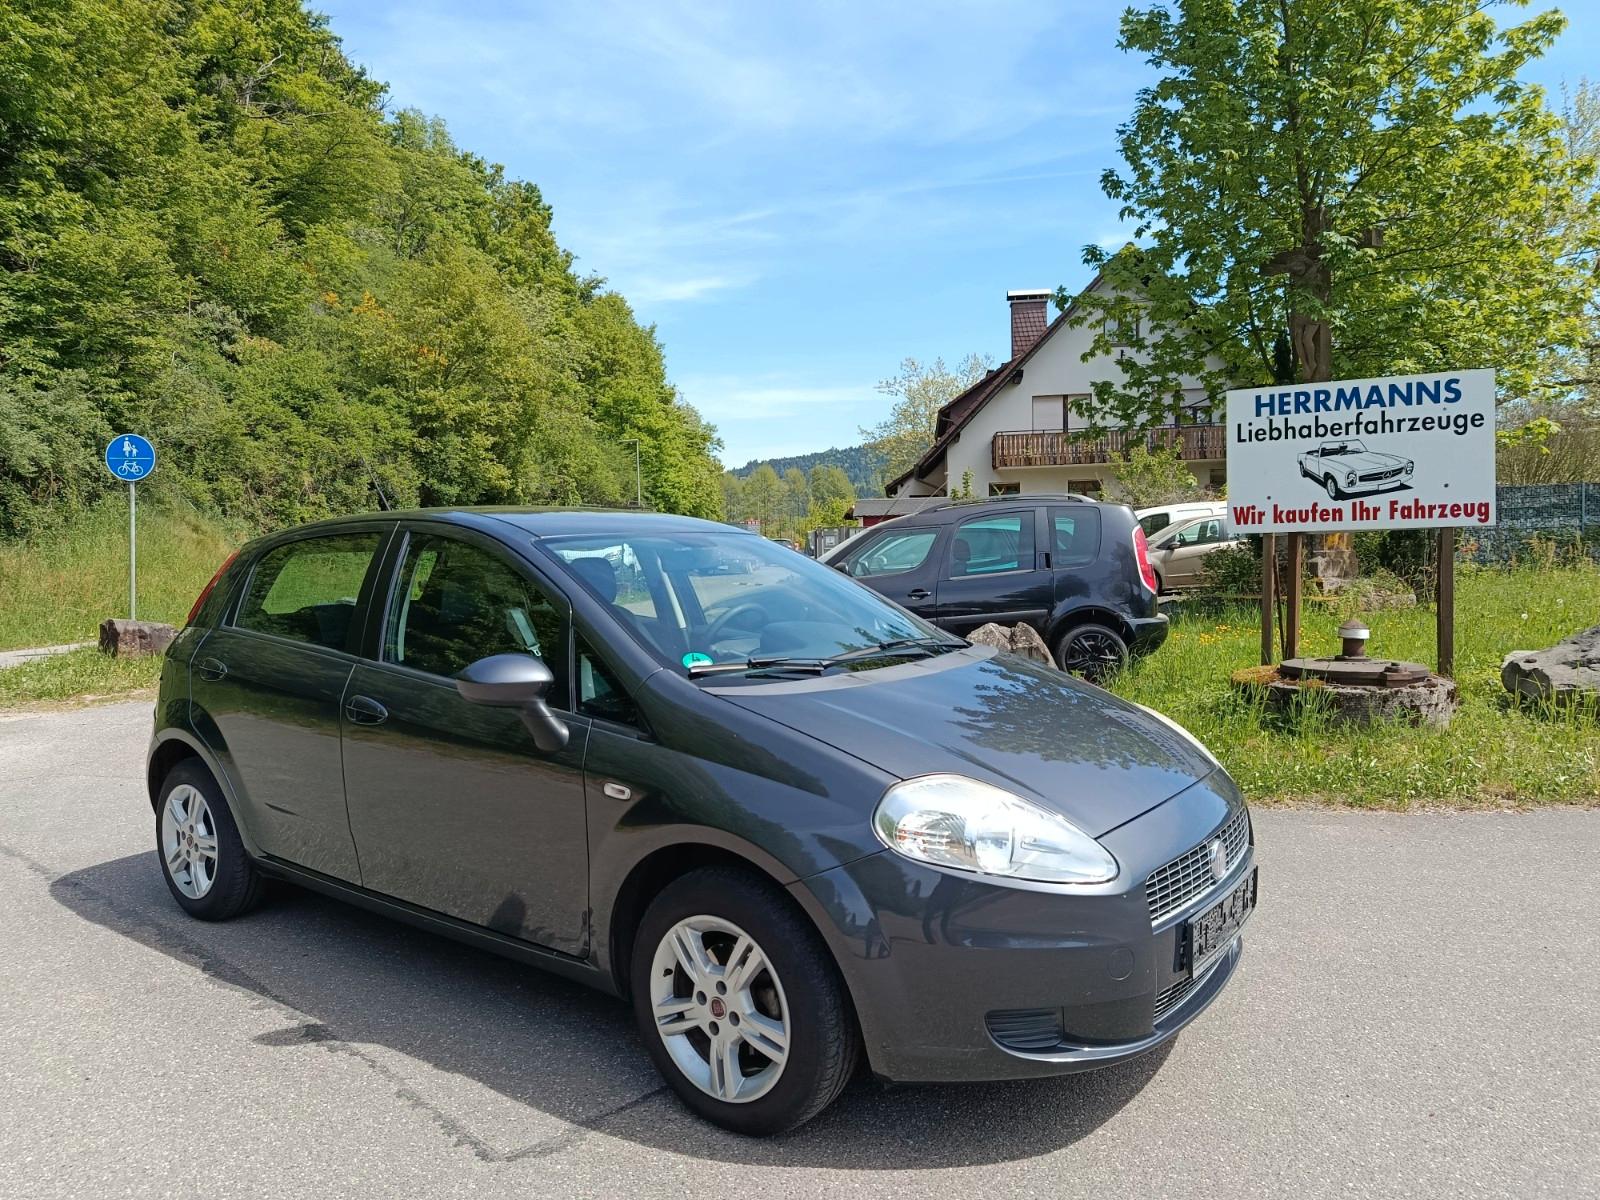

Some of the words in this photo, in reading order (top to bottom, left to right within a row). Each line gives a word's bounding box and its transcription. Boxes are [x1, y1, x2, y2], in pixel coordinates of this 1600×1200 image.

[1254, 378, 1462, 418] HERRMANNS
[1236, 411, 1485, 443] Liebhaberfahrzeuge
[1233, 505, 1266, 526] Wir
[1273, 502, 1344, 524] kaufen
[1352, 501, 1381, 521] Ihr
[1389, 498, 1490, 523] Fahrzeug
